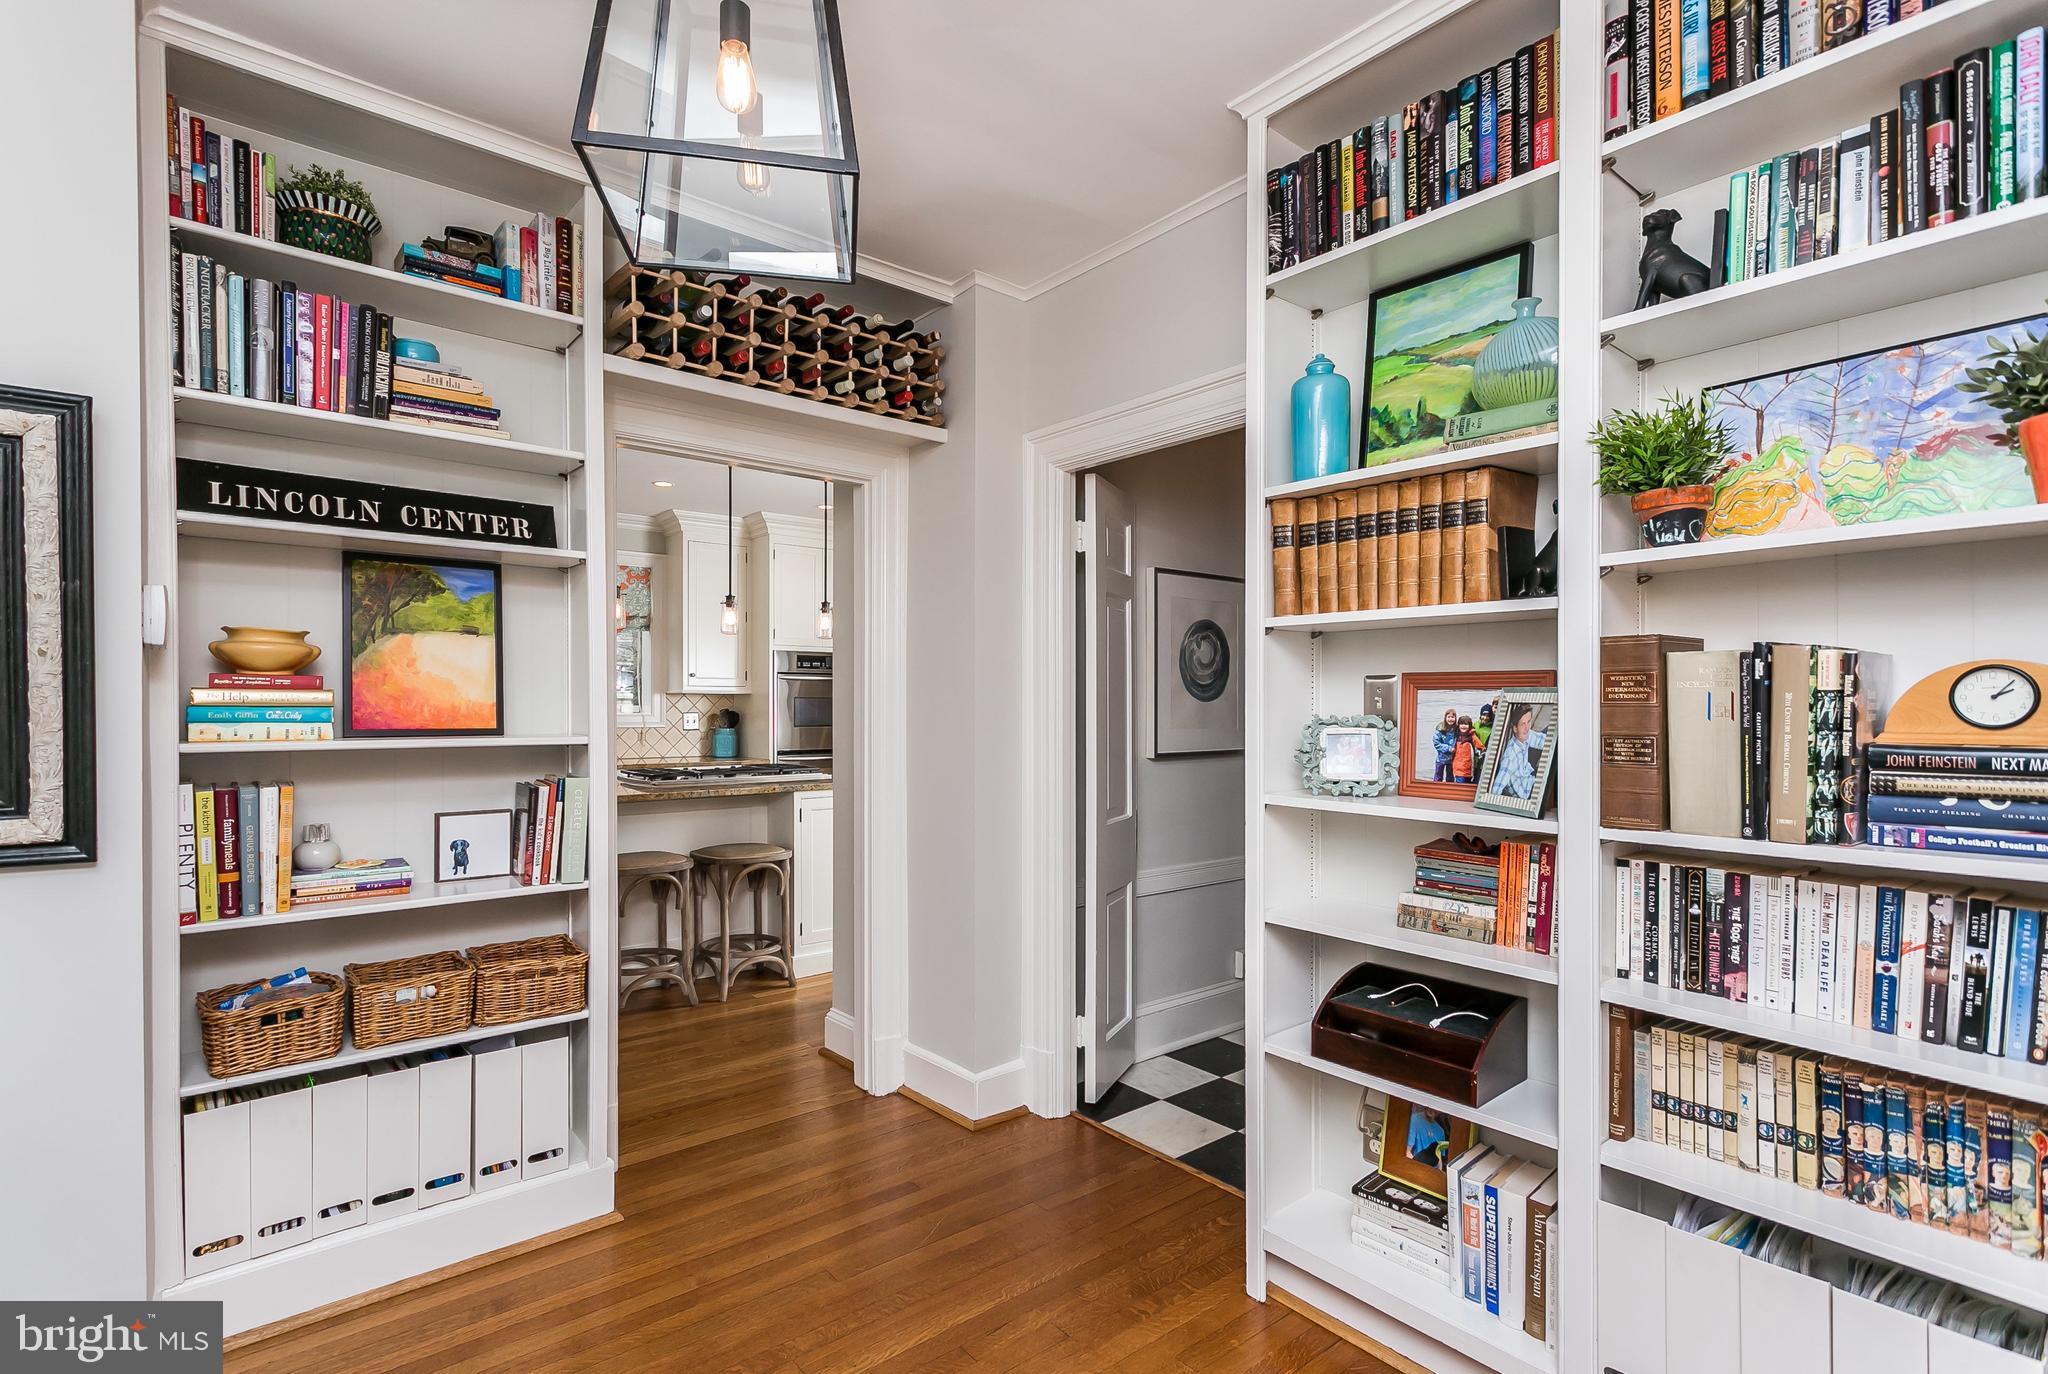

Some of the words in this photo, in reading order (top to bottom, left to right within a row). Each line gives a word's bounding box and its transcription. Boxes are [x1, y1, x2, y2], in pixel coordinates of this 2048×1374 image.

[1711, 20, 1726, 57] CROSS
[1734, 16, 1747, 40] JOHN
[1519, 54, 1528, 74] JOHN
[1536, 42, 1548, 65] JOHN
[1658, 20, 1672, 92] PATTERSON
[1736, 41, 1747, 78] GRISHAM
[2019, 34, 2040, 71] JOHN
[1497, 62, 1512, 90] MIND
[1712, 58, 1726, 84] FIRE
[1519, 75, 1528, 114] SANDFORD
[1537, 67, 1548, 114] SANDFORD
[2020, 71, 2040, 106] DALY
[1459, 102, 1474, 125] John
[1497, 91, 1512, 113] PREY
[1448, 122, 1456, 145] DENNIS
[1497, 114, 1512, 135] JOHN
[1519, 117, 1528, 143] MORTAL
[1880, 116, 1888, 131] JOHN
[1407, 130, 1416, 157] JAMES
[1460, 126, 1474, 165] Sandford
[1519, 144, 1529, 164] PREY
[1355, 150, 1367, 168] John
[1448, 146, 1456, 170] LEHANE
[1497, 135, 1512, 183] SANDFORD
[1854, 152, 1864, 167] john
[1356, 170, 1367, 207] Sandford
[1408, 159, 1417, 207] PATTERSON
[1854, 169, 1864, 201] feinstein
[1880, 209, 1888, 241] AMATEURS
[186, 257, 194, 288] PRIVATE
[544, 260, 554, 281] Little
[201, 267, 211, 329] NUTCRACKER
[364, 345, 371, 354] MY
[365, 336, 371, 344] ON
[375, 351, 390, 399] BALANCHINE
[207, 480, 382, 523] LINCOLN
[401, 505, 533, 540] CENTER
[1741, 658, 1750, 676] Slowing
[1742, 677, 1750, 689] Down
[222, 692, 249, 703] Help
[1742, 695, 1750, 704] See
[1742, 705, 1750, 713] the
[1785, 692, 1793, 706] 20TH
[208, 711, 233, 720] Emily
[1742, 713, 1750, 727] World
[1784, 707, 1793, 733] CENTURY
[1783, 734, 1792, 761] BASEBALL
[1885, 754, 1915, 768] JOHN
[1919, 755, 1976, 769] FEINSTEIN
[1991, 757, 2025, 771] NEXT
[2029, 759, 2048, 771] MA
[1783, 762, 1792, 794] CHRONICLE
[202, 797, 210, 810] the
[574, 789, 583, 829] create
[202, 811, 210, 833] kitchn
[221, 819, 236, 870] familymeals
[246, 825, 254, 852] GENIUS
[1928, 835, 1957, 846] College
[1960, 836, 1998, 848] Football's
[2000, 839, 2035, 851] Greatest
[1648, 872, 1656, 888] THE
[1648, 891, 1656, 913] ROAD
[1823, 892, 1835, 910] Alice
[1885, 891, 1893, 903] THE
[1753, 883, 1763, 940] beautiful
[1822, 912, 1834, 934] Munro
[1881, 905, 1895, 956] POSTMISTRESS
[1931, 914, 1946, 942] Sarah's
[1971, 916, 1979, 937] LEWIS
[1979, 912, 1988, 943] MICHAEL
[1709, 932, 1720, 950] KITE
[1781, 943, 1790, 956] THE
[1926, 945, 1943, 960] Key
[1750, 946, 1763, 967] boy
[1821, 941, 1830, 967] DEAR
[1709, 951, 1720, 983] RUNNER
[1781, 958, 1790, 980] HOURS
[1820, 971, 1829, 992] LIFE
[1881, 979, 1889, 999] SARAH
[1966, 977, 1974, 999] BLIND
[2039, 965, 2047, 1000] COUPLE
[1965, 1001, 1973, 1016] SIDE
[2035, 1023, 2044, 1046] DOOR
[1612, 1089, 1620, 1117] Sawyer
[1364, 1200, 1381, 1212] blink
[1534, 1209, 1546, 1236] Alan
[1486, 1195, 1497, 1289] SUPERFREAKONOMICS
[1530, 1238, 1547, 1298] Greenspan
